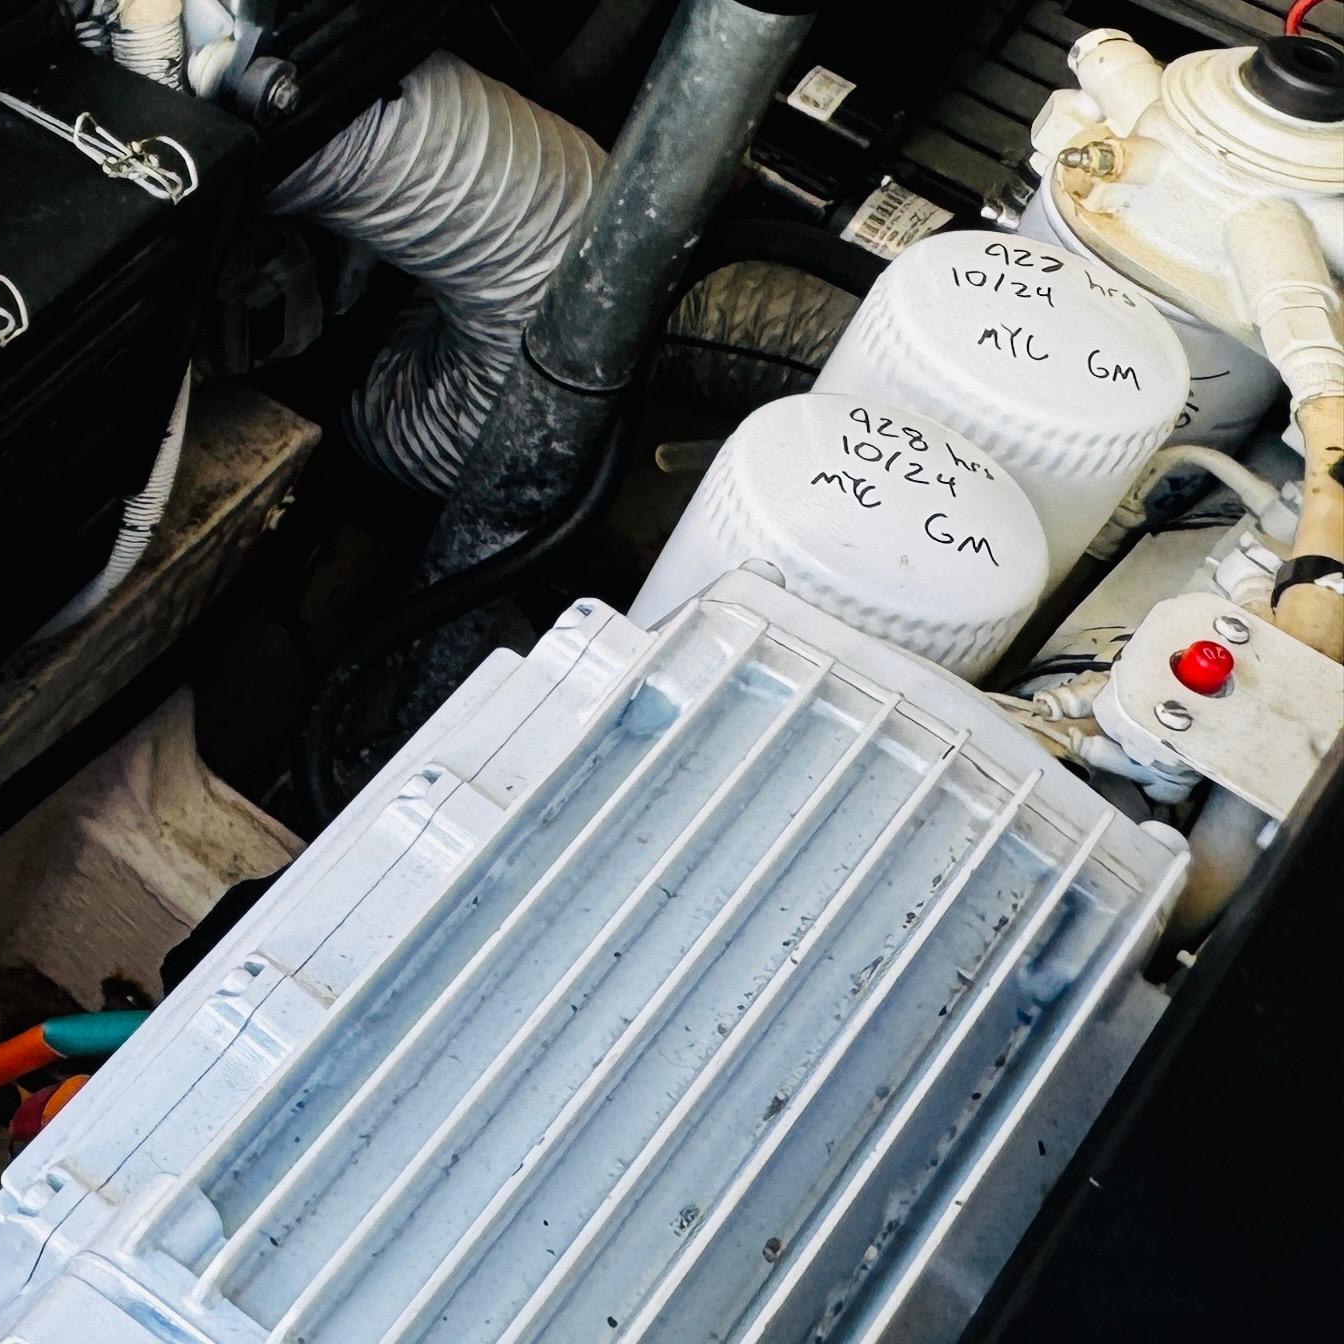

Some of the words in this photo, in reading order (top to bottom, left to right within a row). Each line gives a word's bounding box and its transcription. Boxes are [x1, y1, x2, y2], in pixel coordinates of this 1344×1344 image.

[952, 266, 1055, 308] 10/24
[977, 323, 1049, 361] MYC
[1087, 349, 1141, 391] GM
[849, 407, 929, 452] 928
[842, 435, 956, 498] 10/24
[924, 513, 1000, 567] GM
